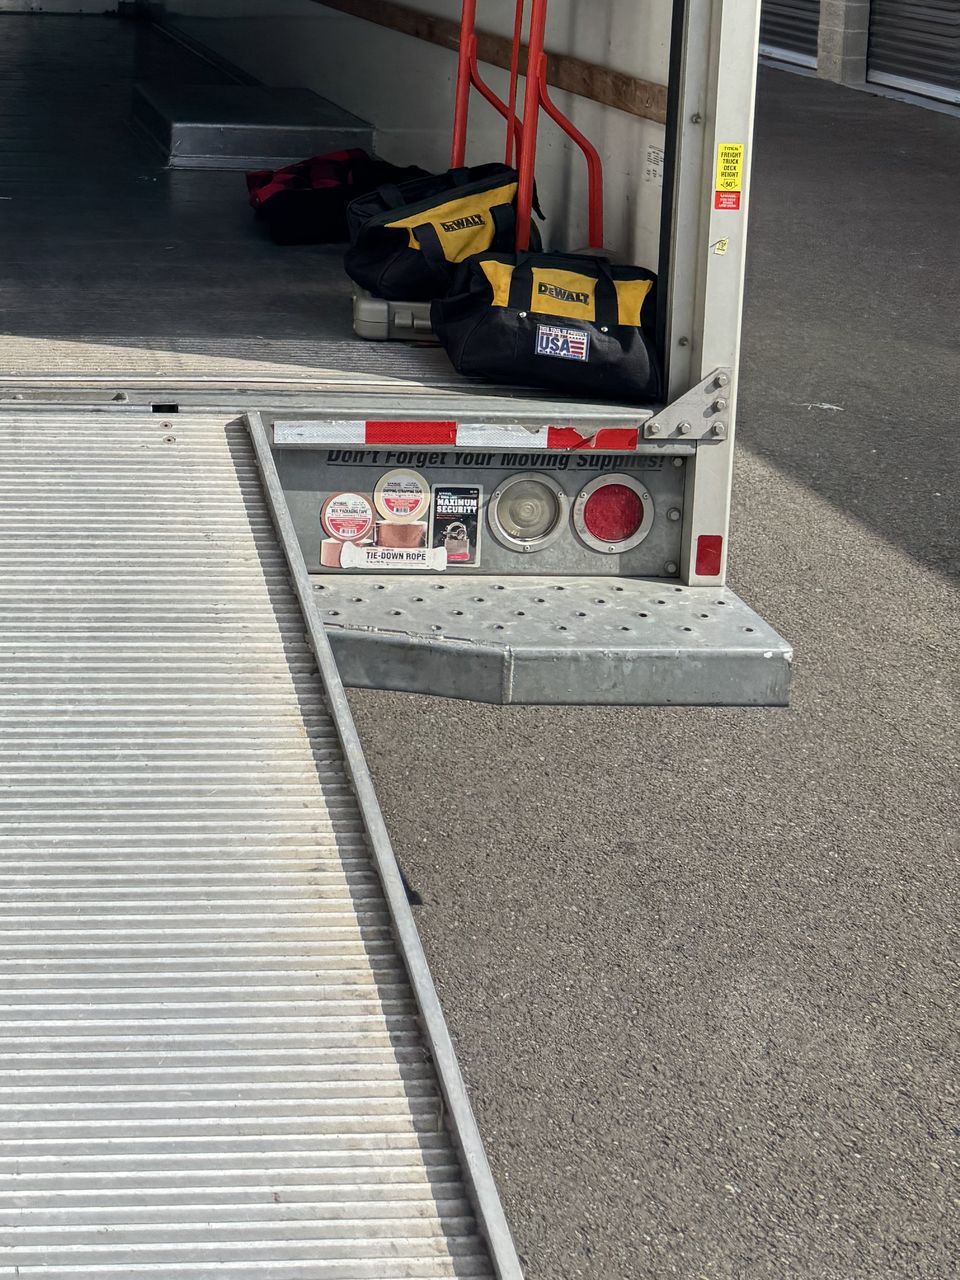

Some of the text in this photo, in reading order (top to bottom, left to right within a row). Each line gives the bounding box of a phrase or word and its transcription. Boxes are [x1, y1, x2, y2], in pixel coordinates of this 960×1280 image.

[540, 335, 570, 353] USA
[327, 450, 666, 470] Don't Forget Your Moving Supplies!
[437, 498, 477, 507] MAXIMUM
[436, 506, 478, 514] SECURITY
[366, 551, 426, 561] TIE-DOWN ROPE
